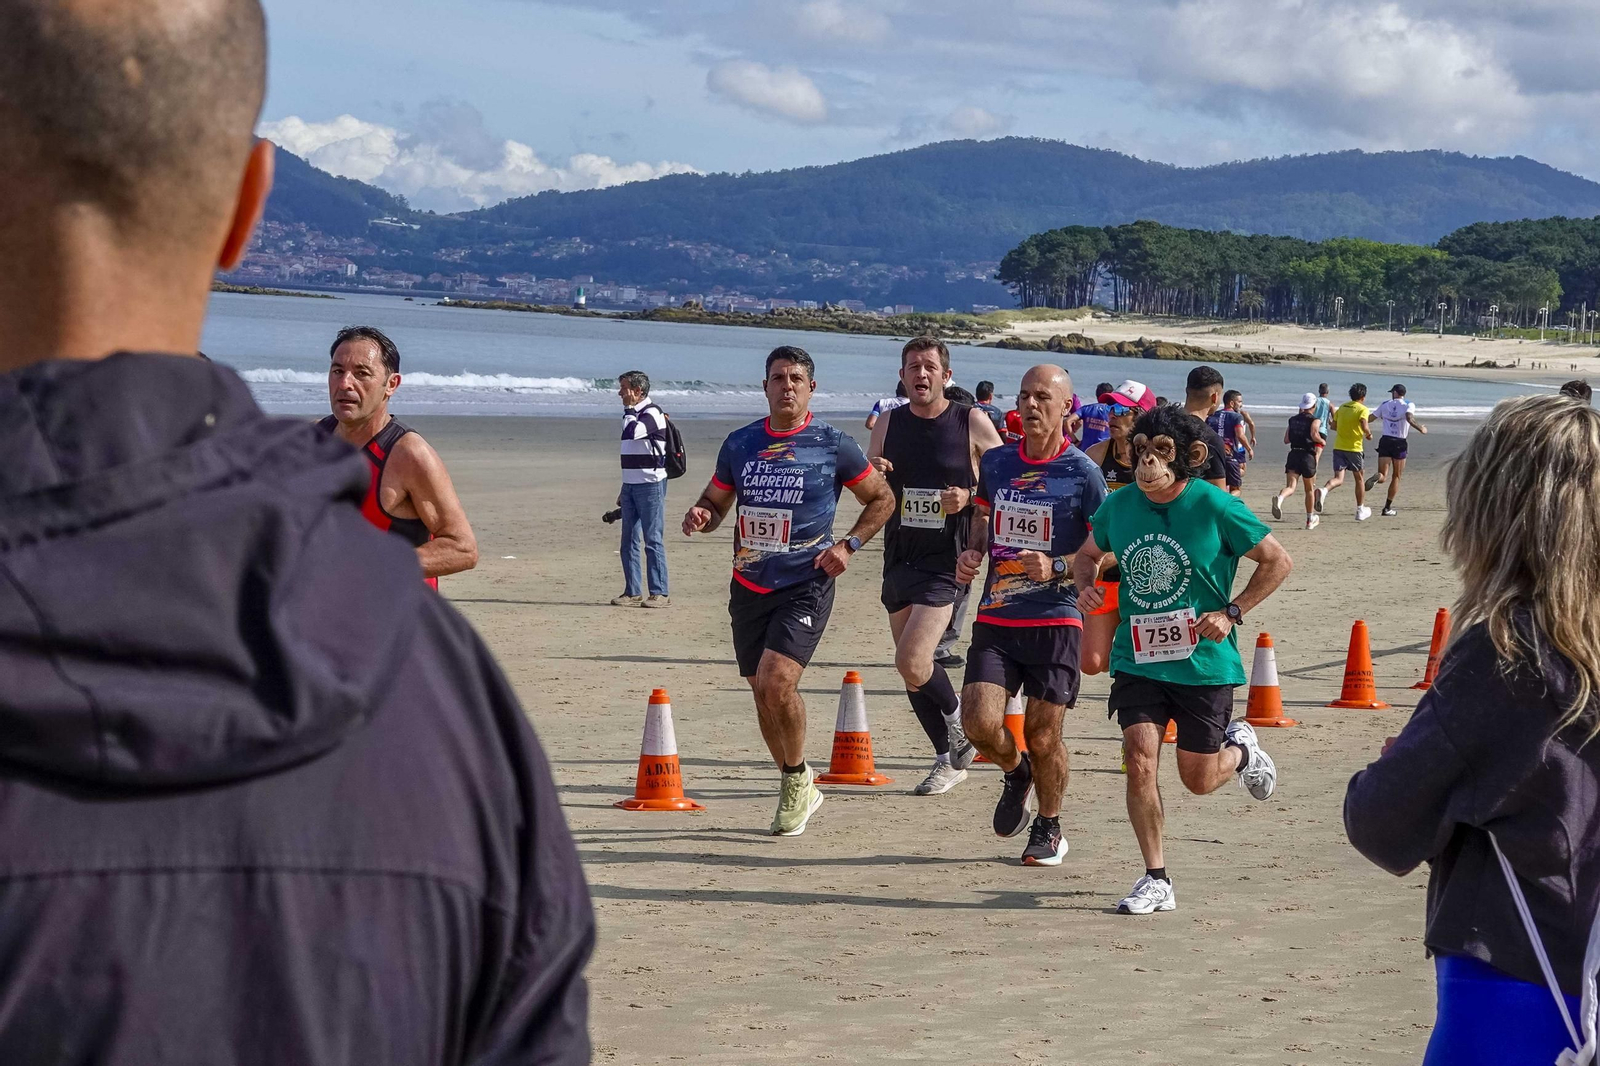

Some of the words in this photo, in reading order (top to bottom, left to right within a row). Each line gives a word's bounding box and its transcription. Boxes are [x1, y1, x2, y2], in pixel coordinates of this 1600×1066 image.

[755, 460, 773, 473] FE
[773, 467, 804, 476] seguros
[743, 475, 804, 489] CARREIRA
[763, 489, 805, 504] SAMIL
[1009, 489, 1026, 503] FE
[905, 500, 941, 514] 4150
[749, 521, 775, 537] 151
[1007, 516, 1038, 534] 146
[1144, 533, 1155, 542] DE
[1157, 533, 1191, 566] ENFERMOS
[1153, 577, 1190, 609] ALEXANDER
[1145, 625, 1182, 644] 758
